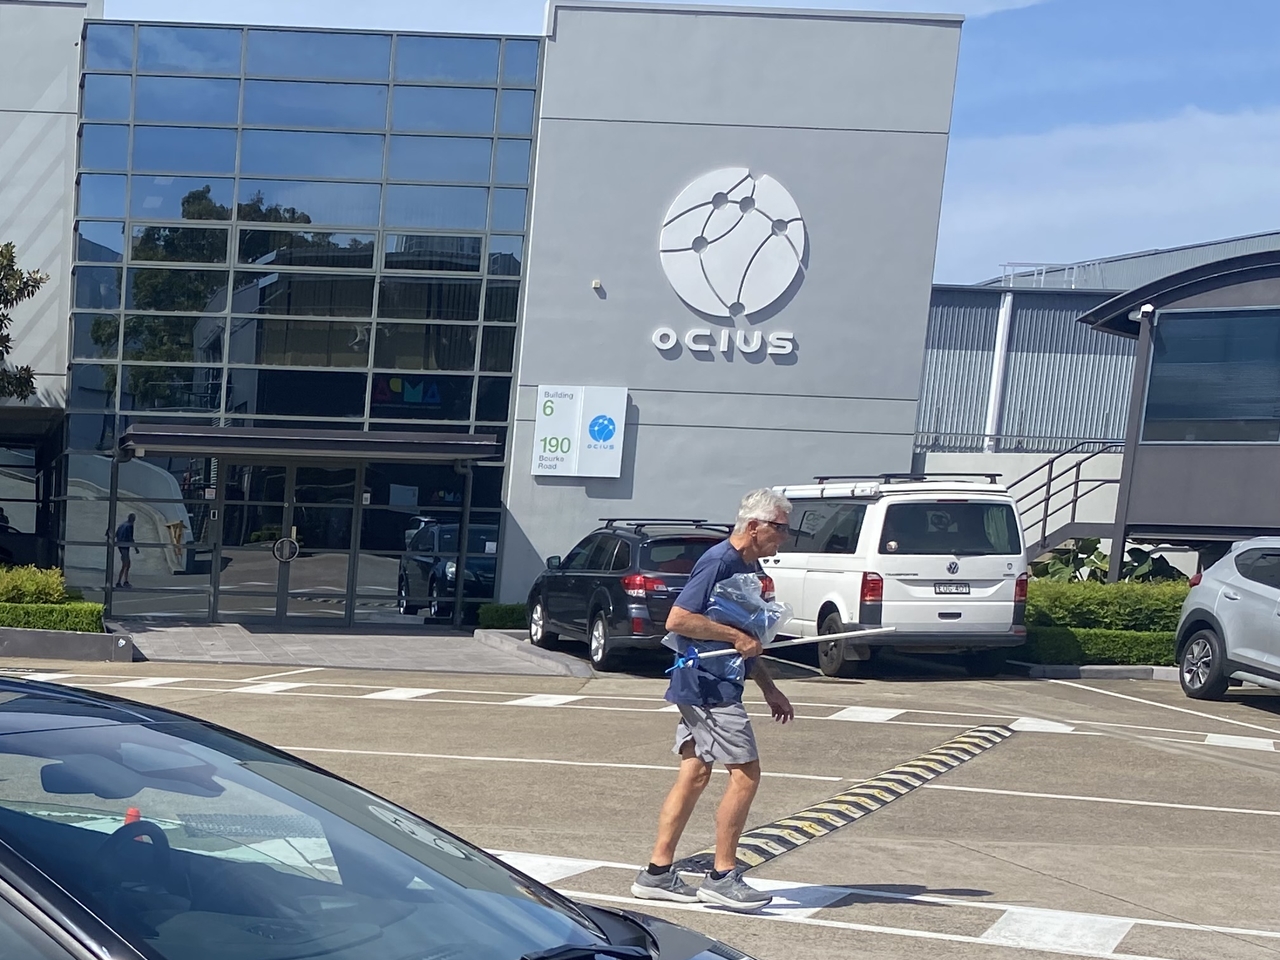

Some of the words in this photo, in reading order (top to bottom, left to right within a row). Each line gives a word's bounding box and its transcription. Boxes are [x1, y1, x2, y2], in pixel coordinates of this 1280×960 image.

[652, 327, 794, 355] OCIUS
[544, 391, 574, 400] Building
[542, 400, 554, 416] 6
[540, 437, 571, 454] 190
[538, 462, 557, 470] Road
